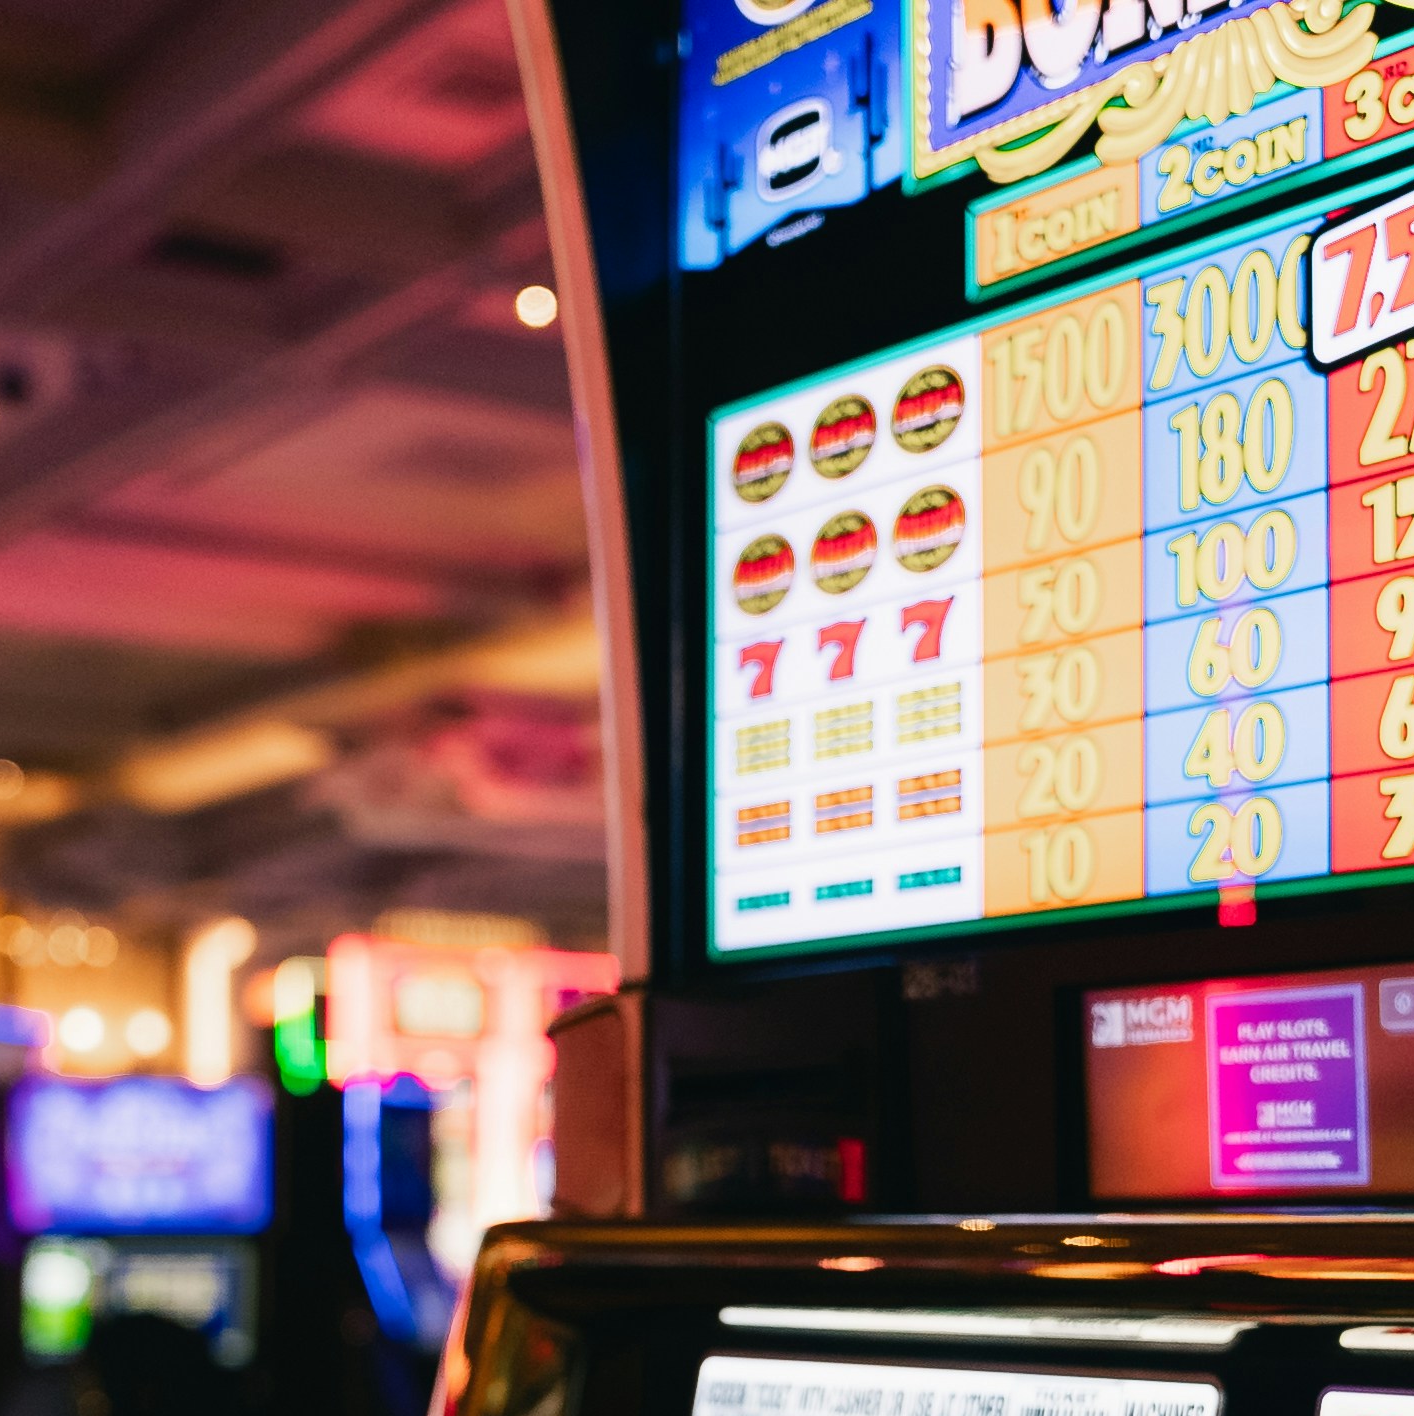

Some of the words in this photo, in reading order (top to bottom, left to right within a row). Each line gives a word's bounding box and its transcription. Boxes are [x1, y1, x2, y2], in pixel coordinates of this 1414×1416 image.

[1193, 118, 1307, 196] COIN
[1018, 188, 1119, 261] COIN
[1147, 234, 1311, 390] 3000
[988, 300, 1127, 438] 1500
[1172, 378, 1294, 511] 180
[1019, 436, 1099, 552] 90
[1169, 509, 1296, 607] 100
[1019, 559, 1101, 644] 50
[739, 637, 784, 698] 7
[817, 617, 868, 680] 7
[900, 596, 955, 662] 7
[1019, 646, 1101, 731] 30
[1187, 607, 1281, 697] 60
[1018, 735, 1101, 819] 20
[1185, 701, 1285, 787] 40
[1023, 824, 1093, 902] 10
[1189, 797, 1282, 882] 20
[1237, 1021, 1276, 1042] PLAY
[1292, 1038, 1352, 1060] TRAVEL
